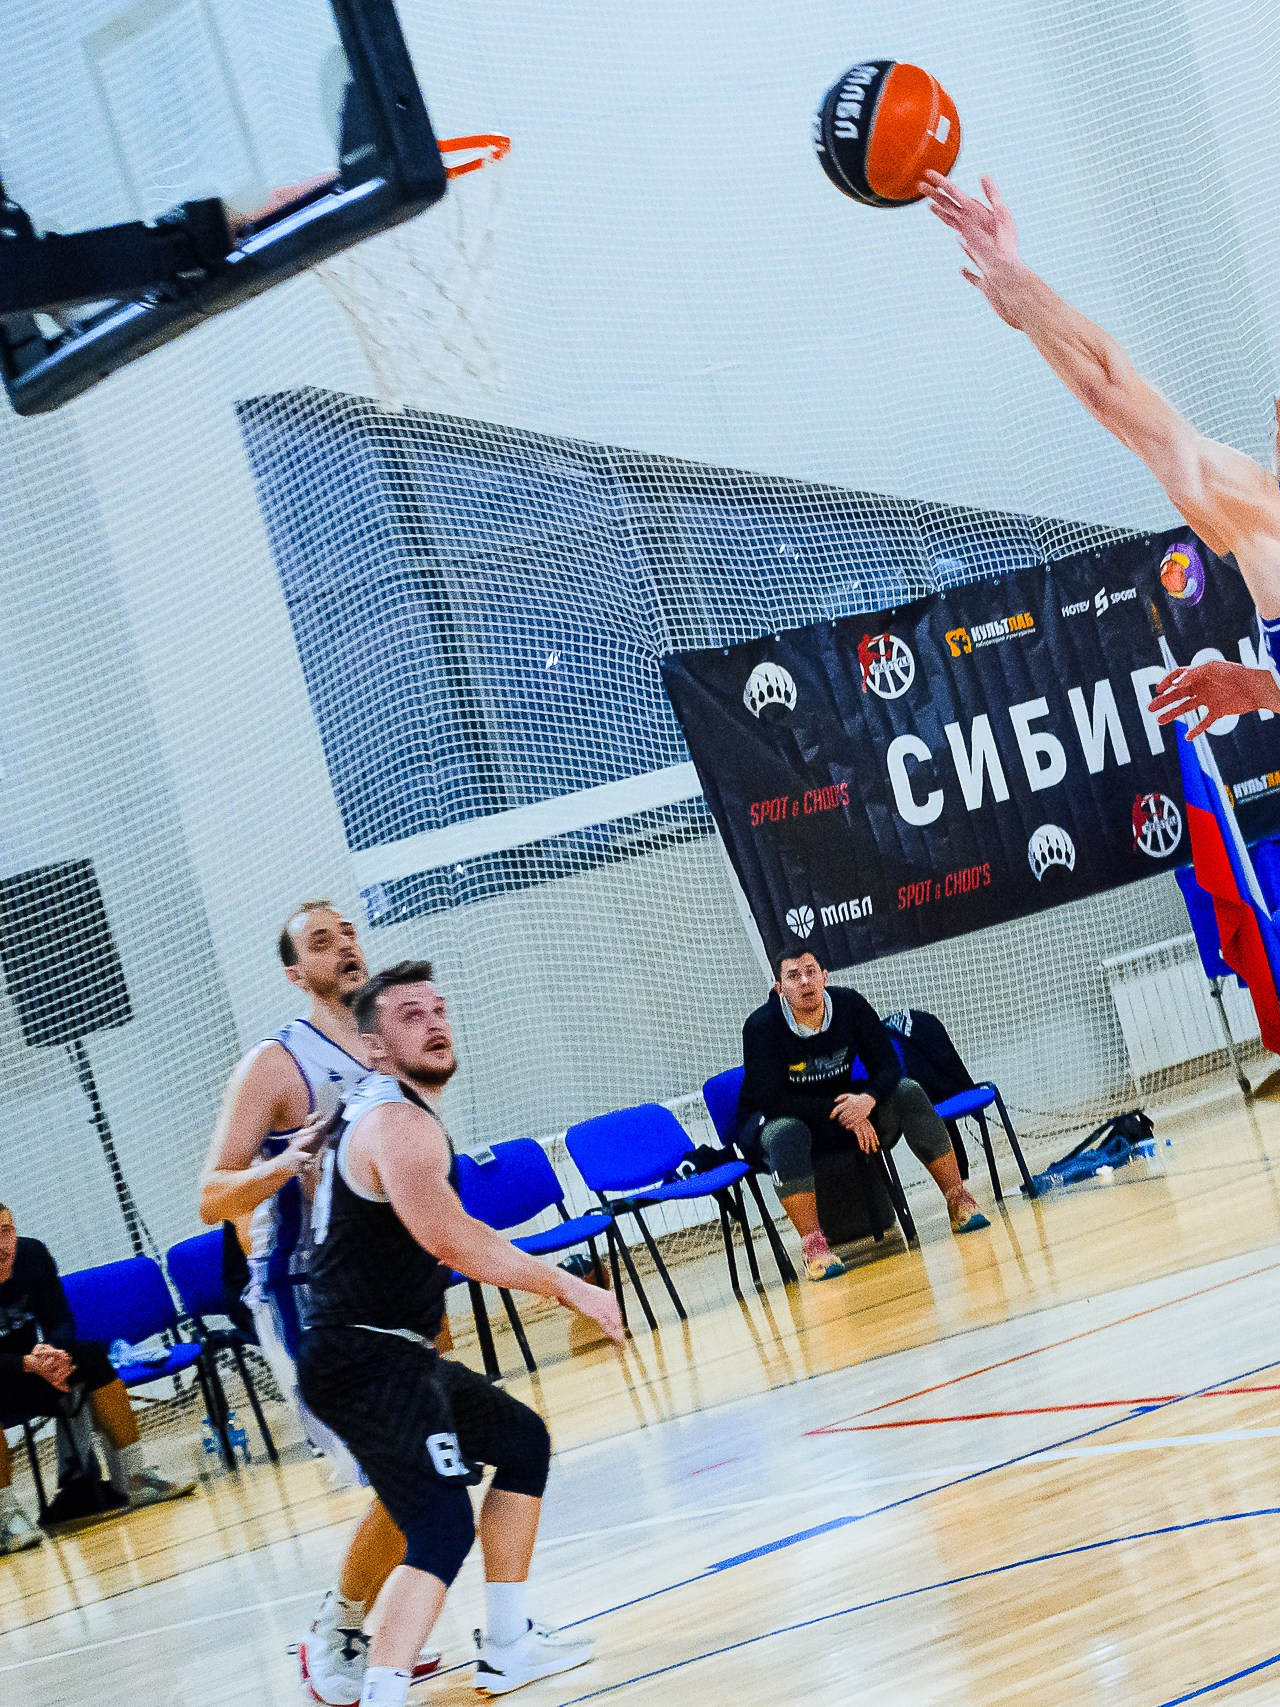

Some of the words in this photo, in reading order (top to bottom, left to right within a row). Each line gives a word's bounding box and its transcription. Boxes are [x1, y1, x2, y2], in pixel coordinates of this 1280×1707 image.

[751, 795, 789, 826] SPOT
[897, 879, 932, 910] SPOT
[820, 895, 873, 927] МЛБЛ
[425, 1432, 470, 1477] 6
